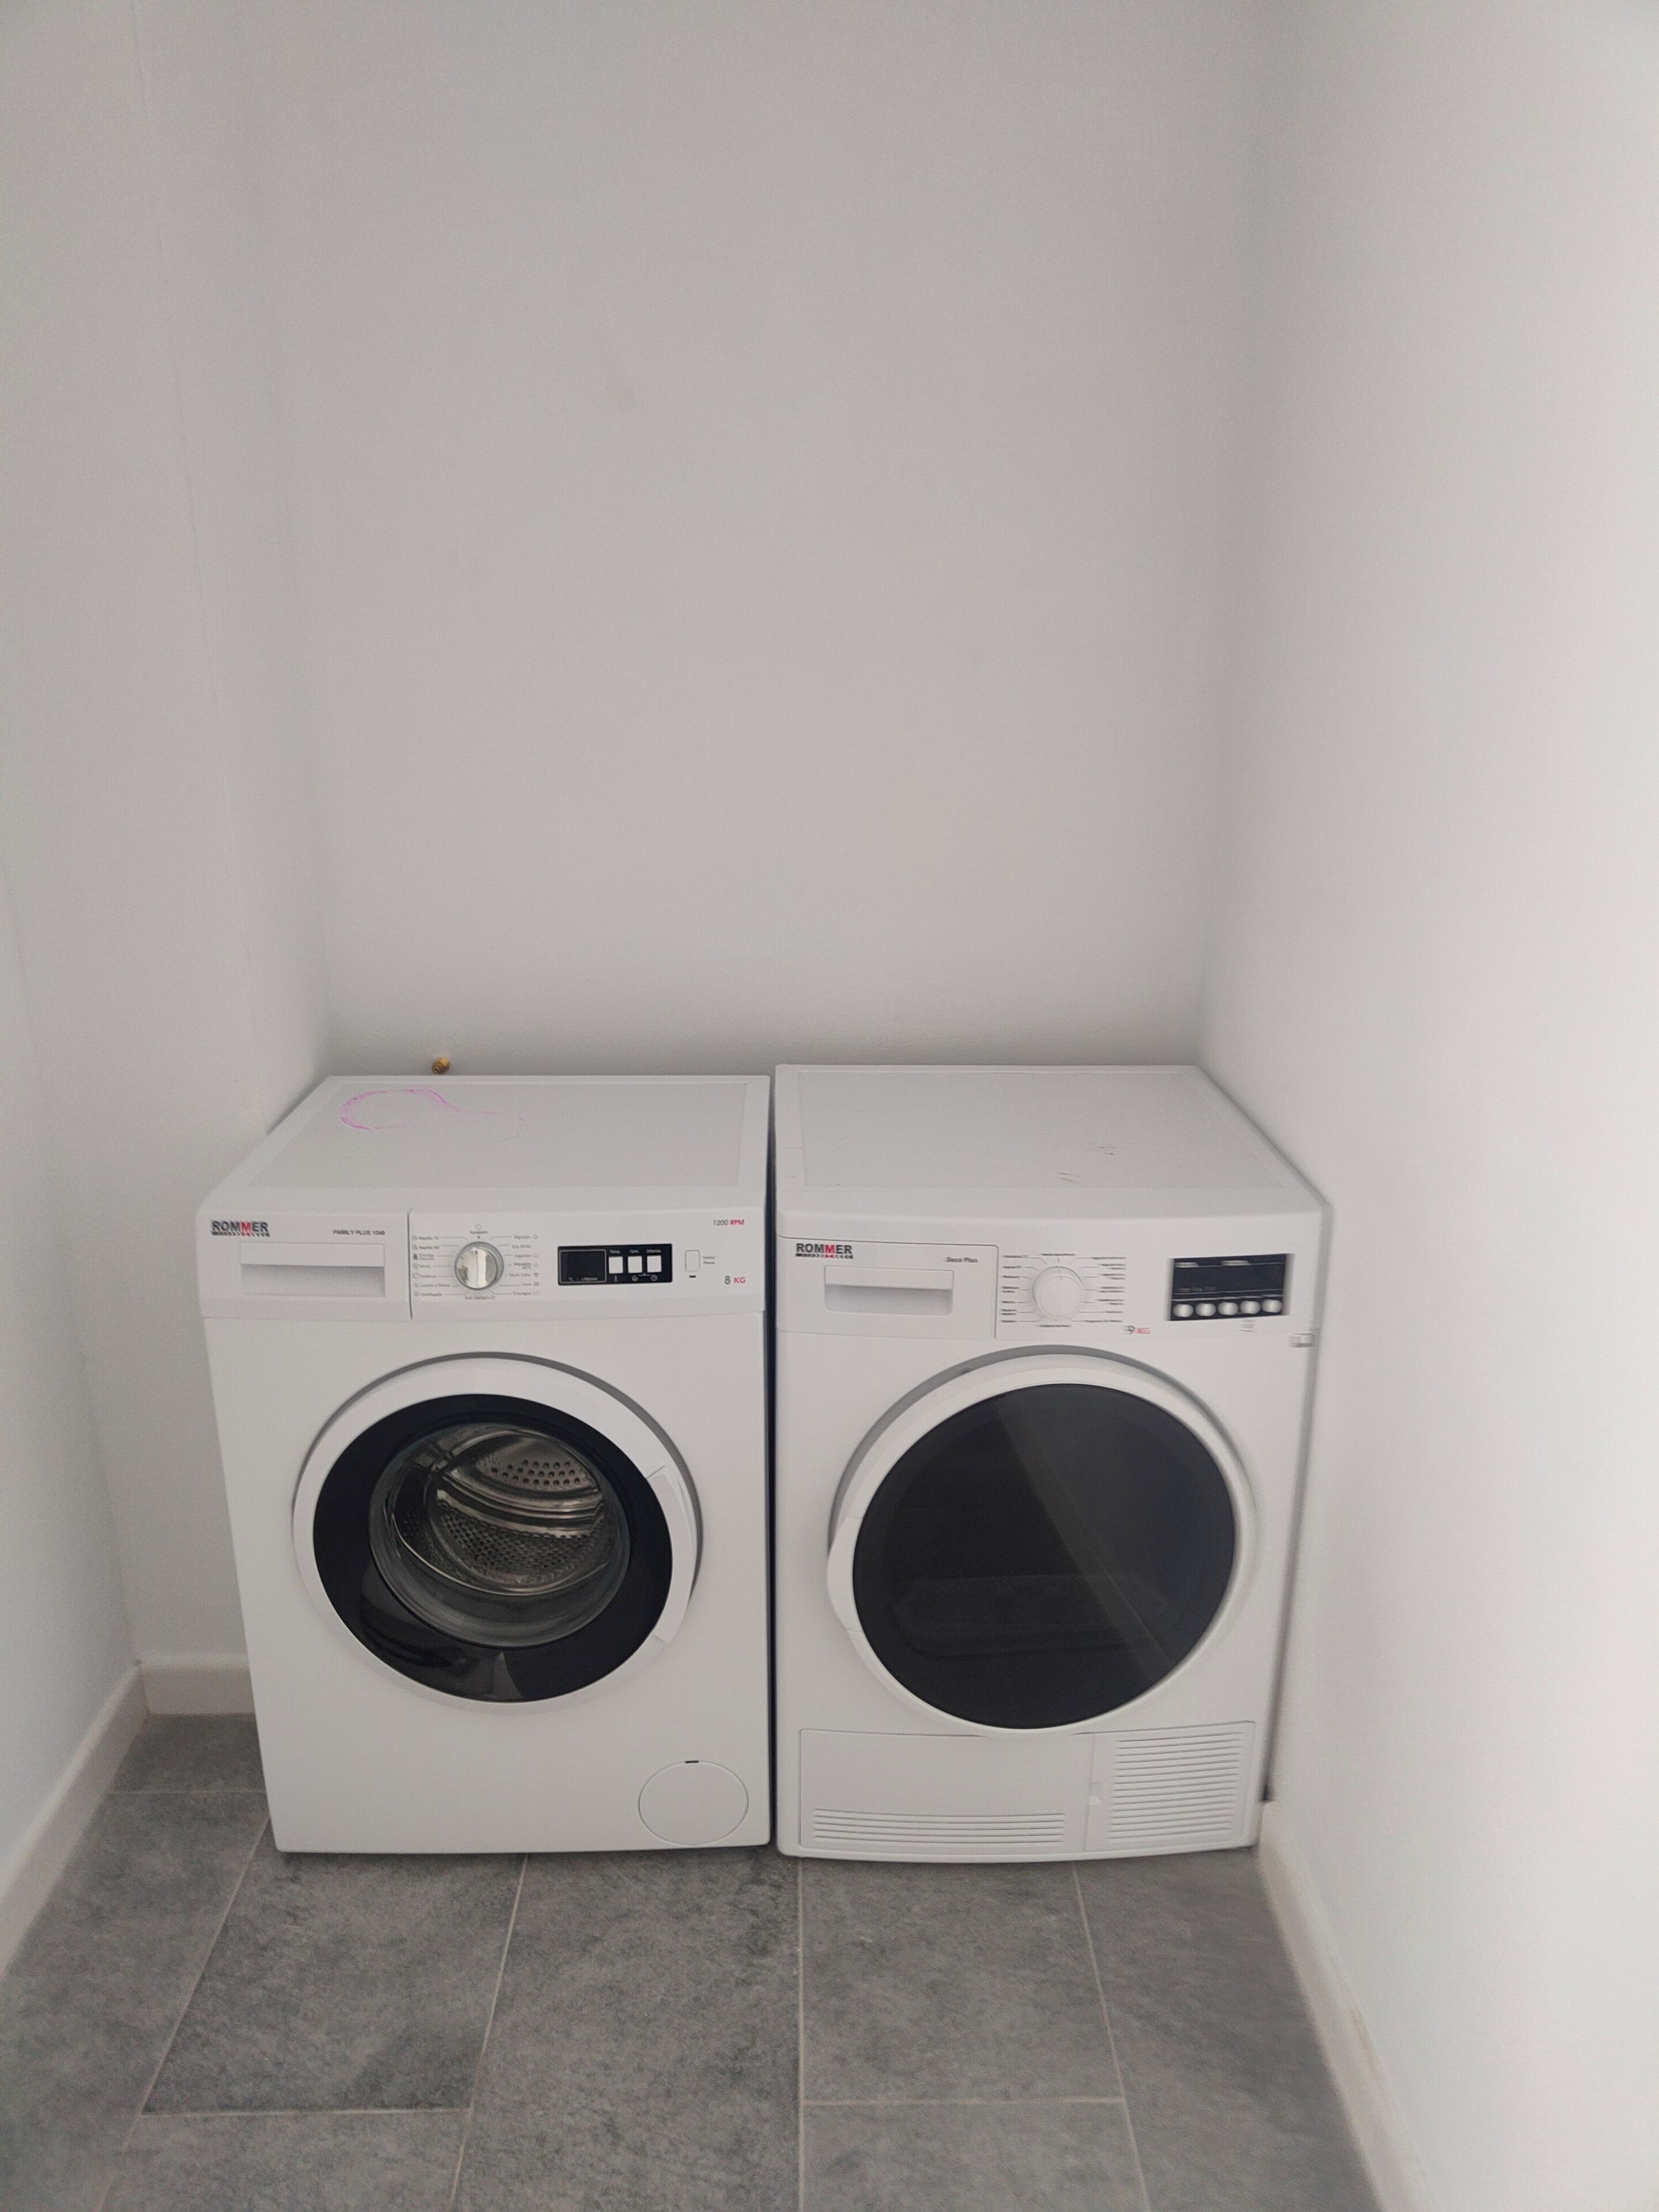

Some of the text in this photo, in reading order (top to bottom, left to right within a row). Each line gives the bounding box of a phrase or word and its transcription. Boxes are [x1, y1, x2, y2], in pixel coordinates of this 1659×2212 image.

[211, 1221, 268, 1232] ROMMER
[796, 1243, 853, 1255] ROMMER
[725, 1275, 730, 1285] 8
